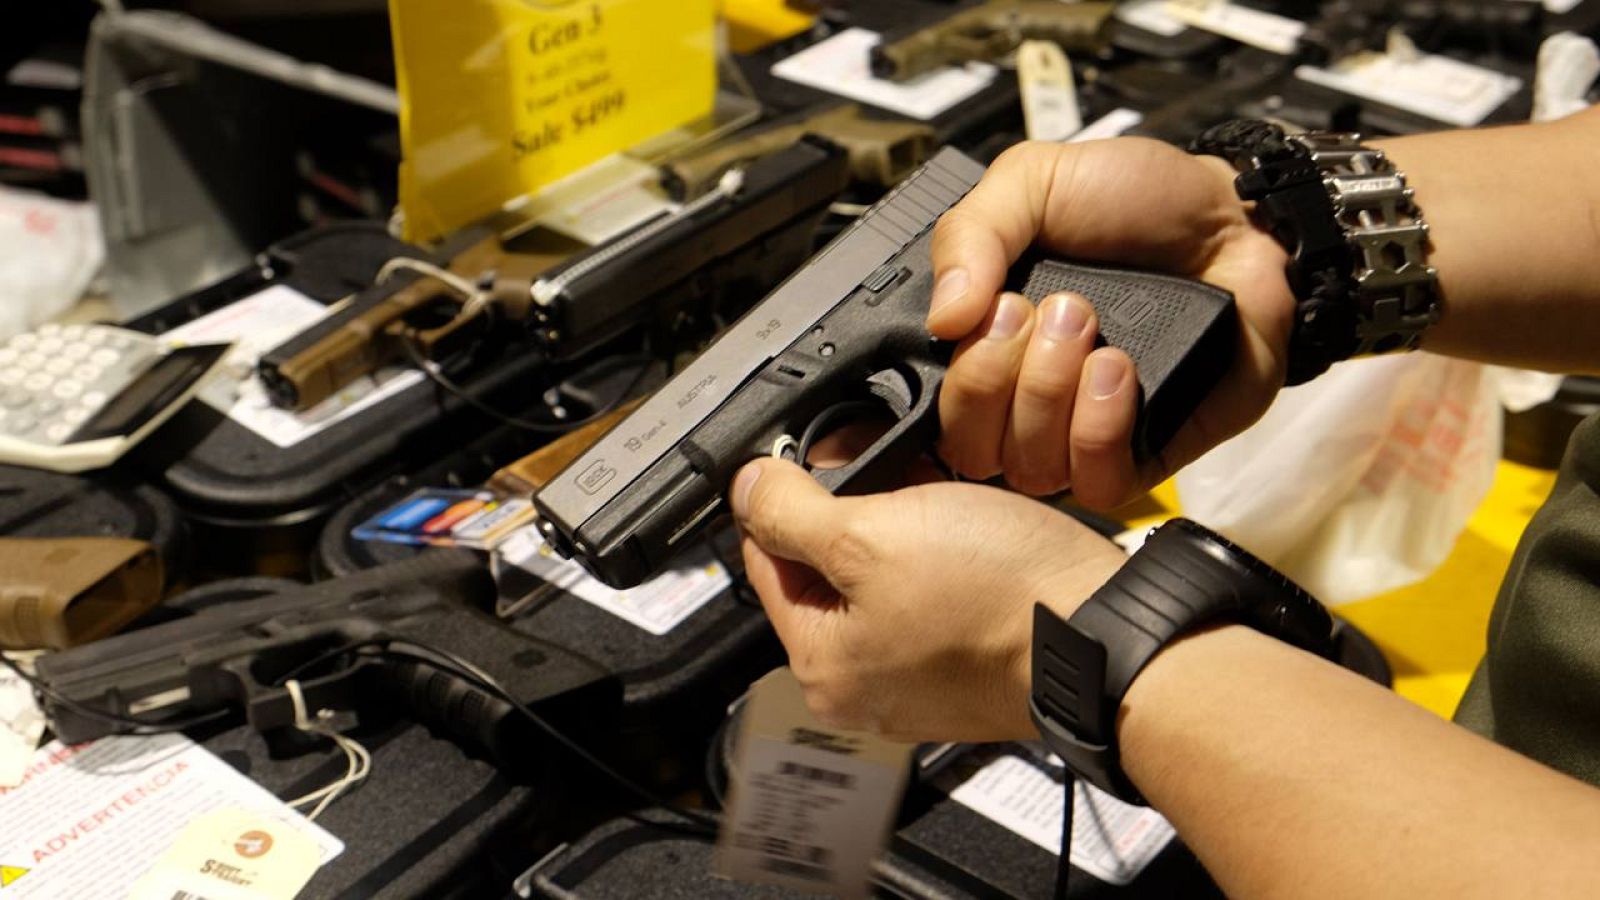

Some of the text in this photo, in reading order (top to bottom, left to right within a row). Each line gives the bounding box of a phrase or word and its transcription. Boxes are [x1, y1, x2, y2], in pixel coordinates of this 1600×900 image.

[528, 20, 580, 56] Gen
[511, 122, 564, 158] Sale
[623, 436, 643, 453] 19
[676, 374, 718, 409] AUSTRIA
[32, 760, 189, 864] ADVERTENCIA
